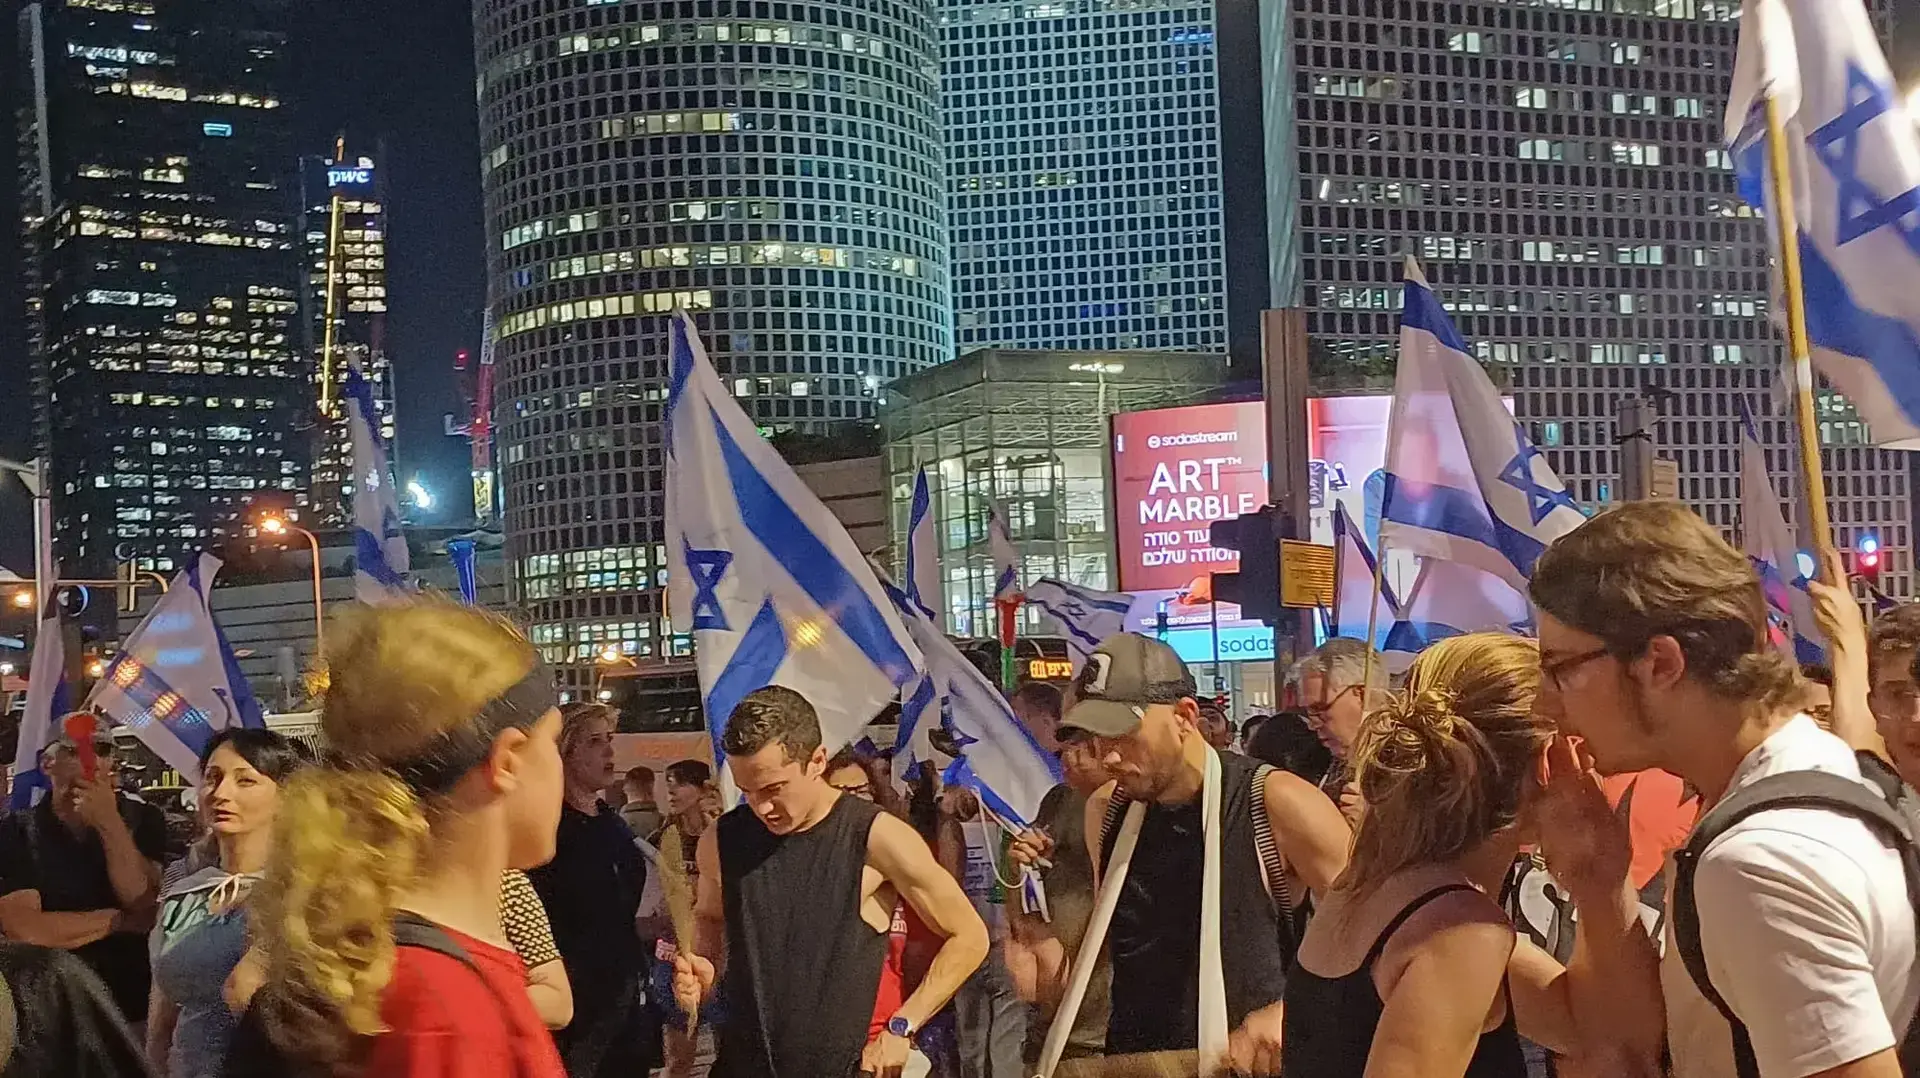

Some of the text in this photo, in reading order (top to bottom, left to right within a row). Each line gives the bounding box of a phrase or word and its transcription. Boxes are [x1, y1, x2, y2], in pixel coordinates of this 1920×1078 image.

[327, 170, 370, 187] pwc
[1161, 431, 1238, 447] sodastream
[1139, 493, 1255, 525] MARBLE
[1143, 530, 1180, 547] סודה
[1142, 547, 1187, 566] שלכם
